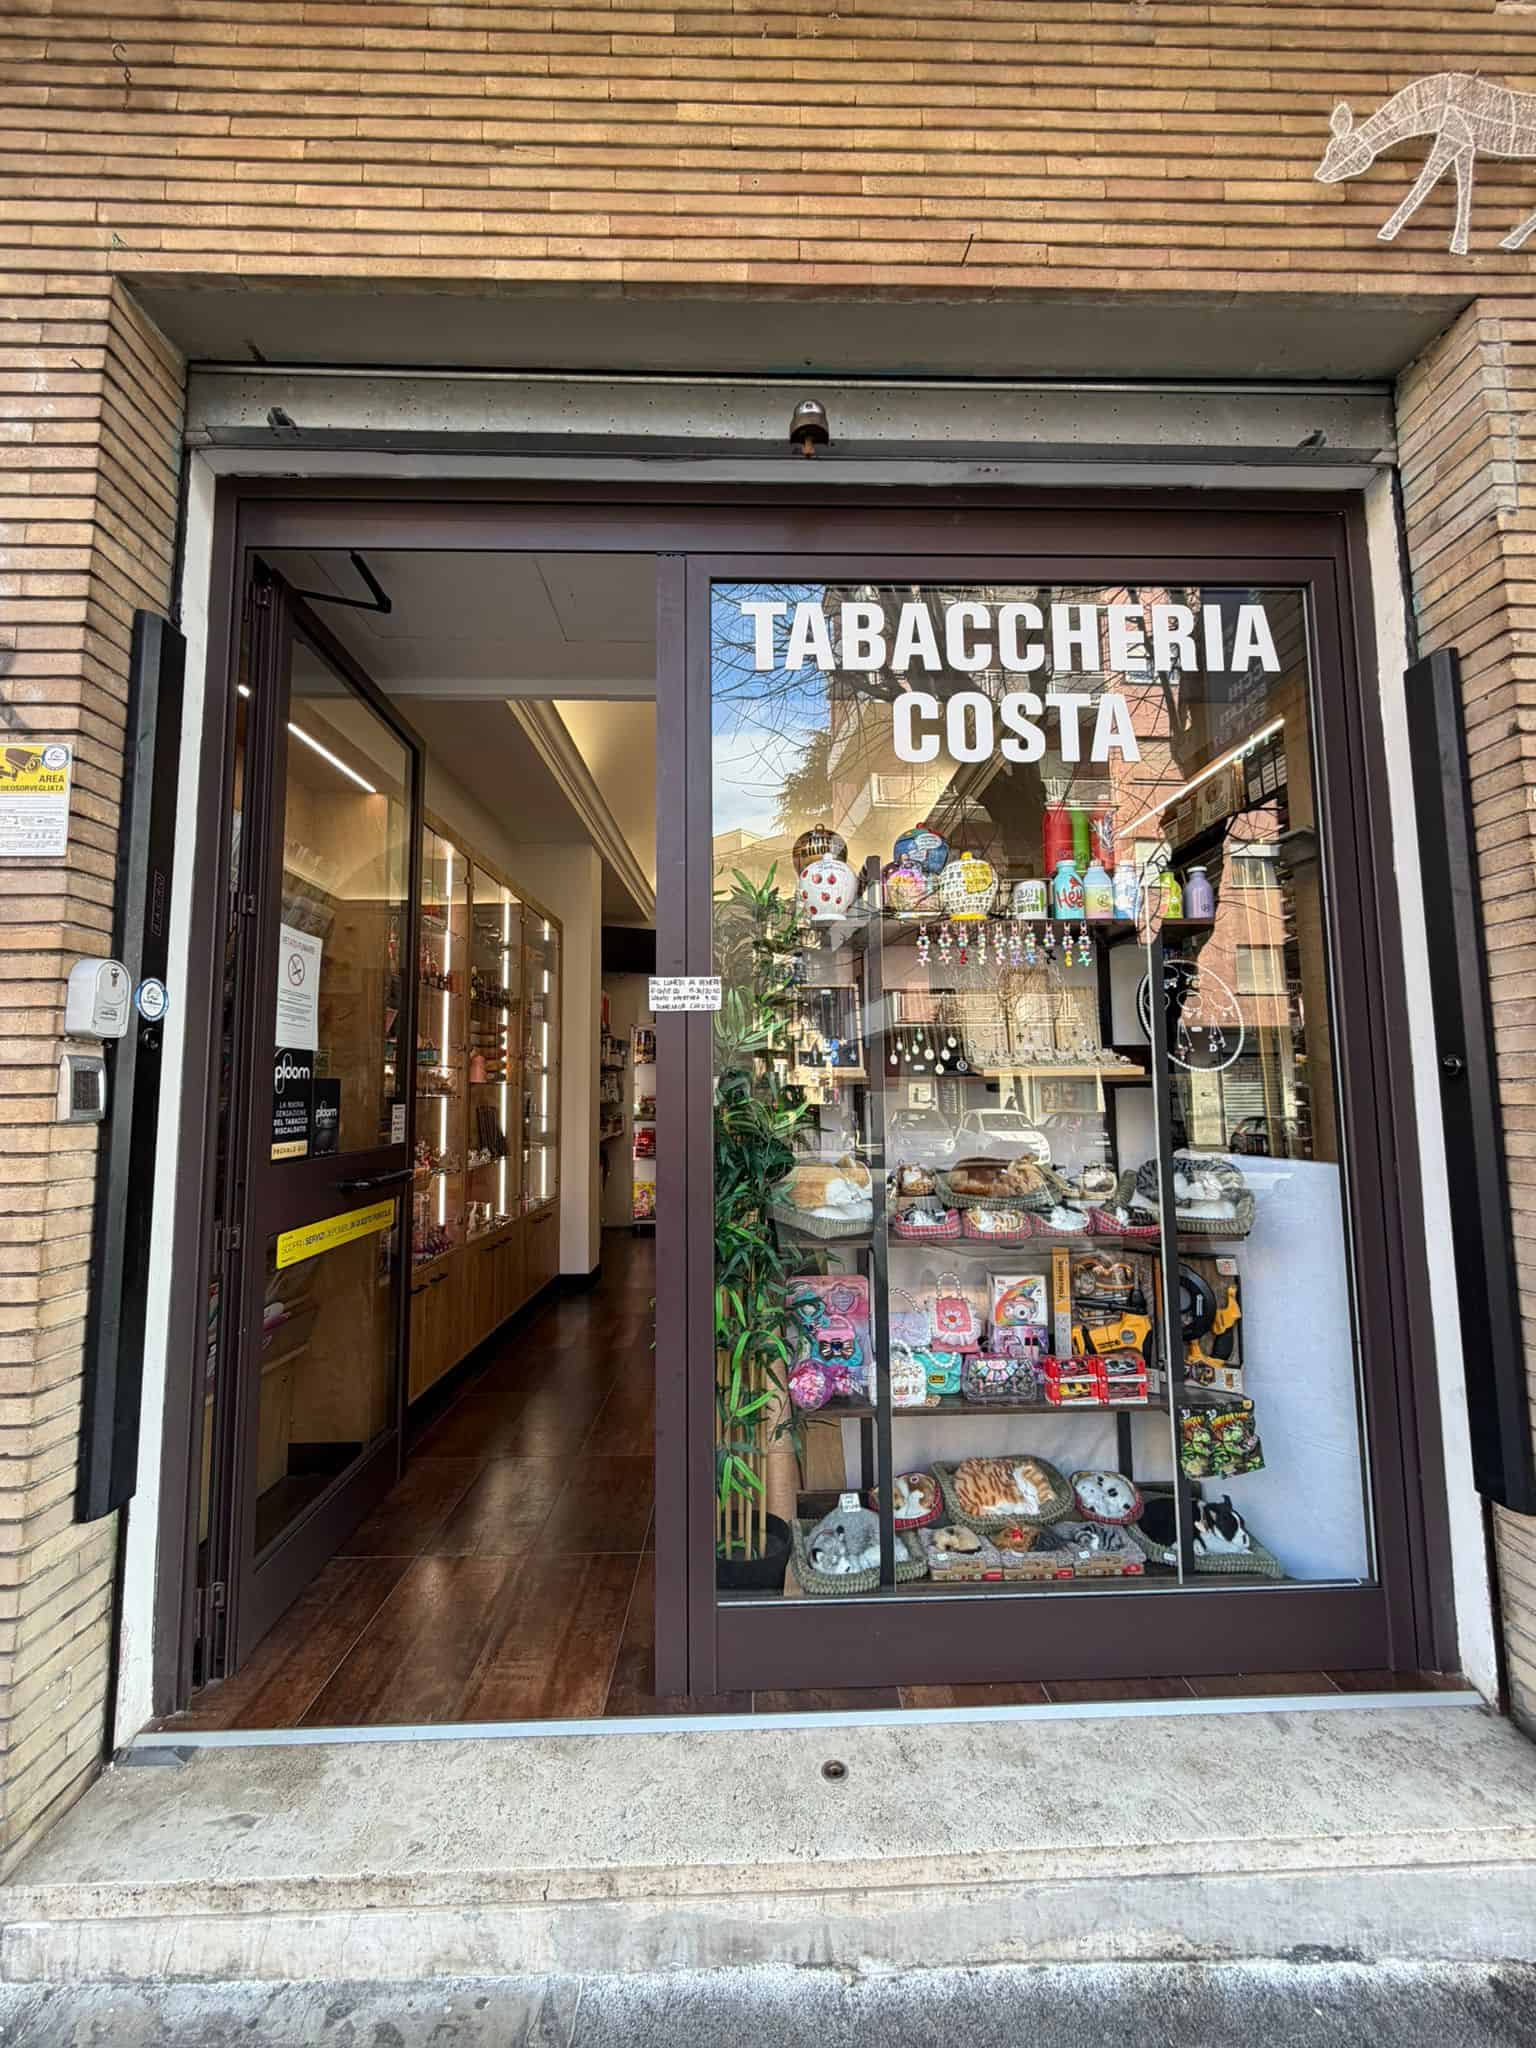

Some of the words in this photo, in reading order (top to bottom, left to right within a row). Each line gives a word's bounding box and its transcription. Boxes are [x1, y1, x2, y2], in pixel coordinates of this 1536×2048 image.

[741, 601, 1281, 673] TABACCHERIA
[893, 691, 1142, 764] COSTA
[38, 774, 65, 784] AREA
[274, 1053, 310, 1094] ploom
[285, 1117, 308, 1126] TABACCO
